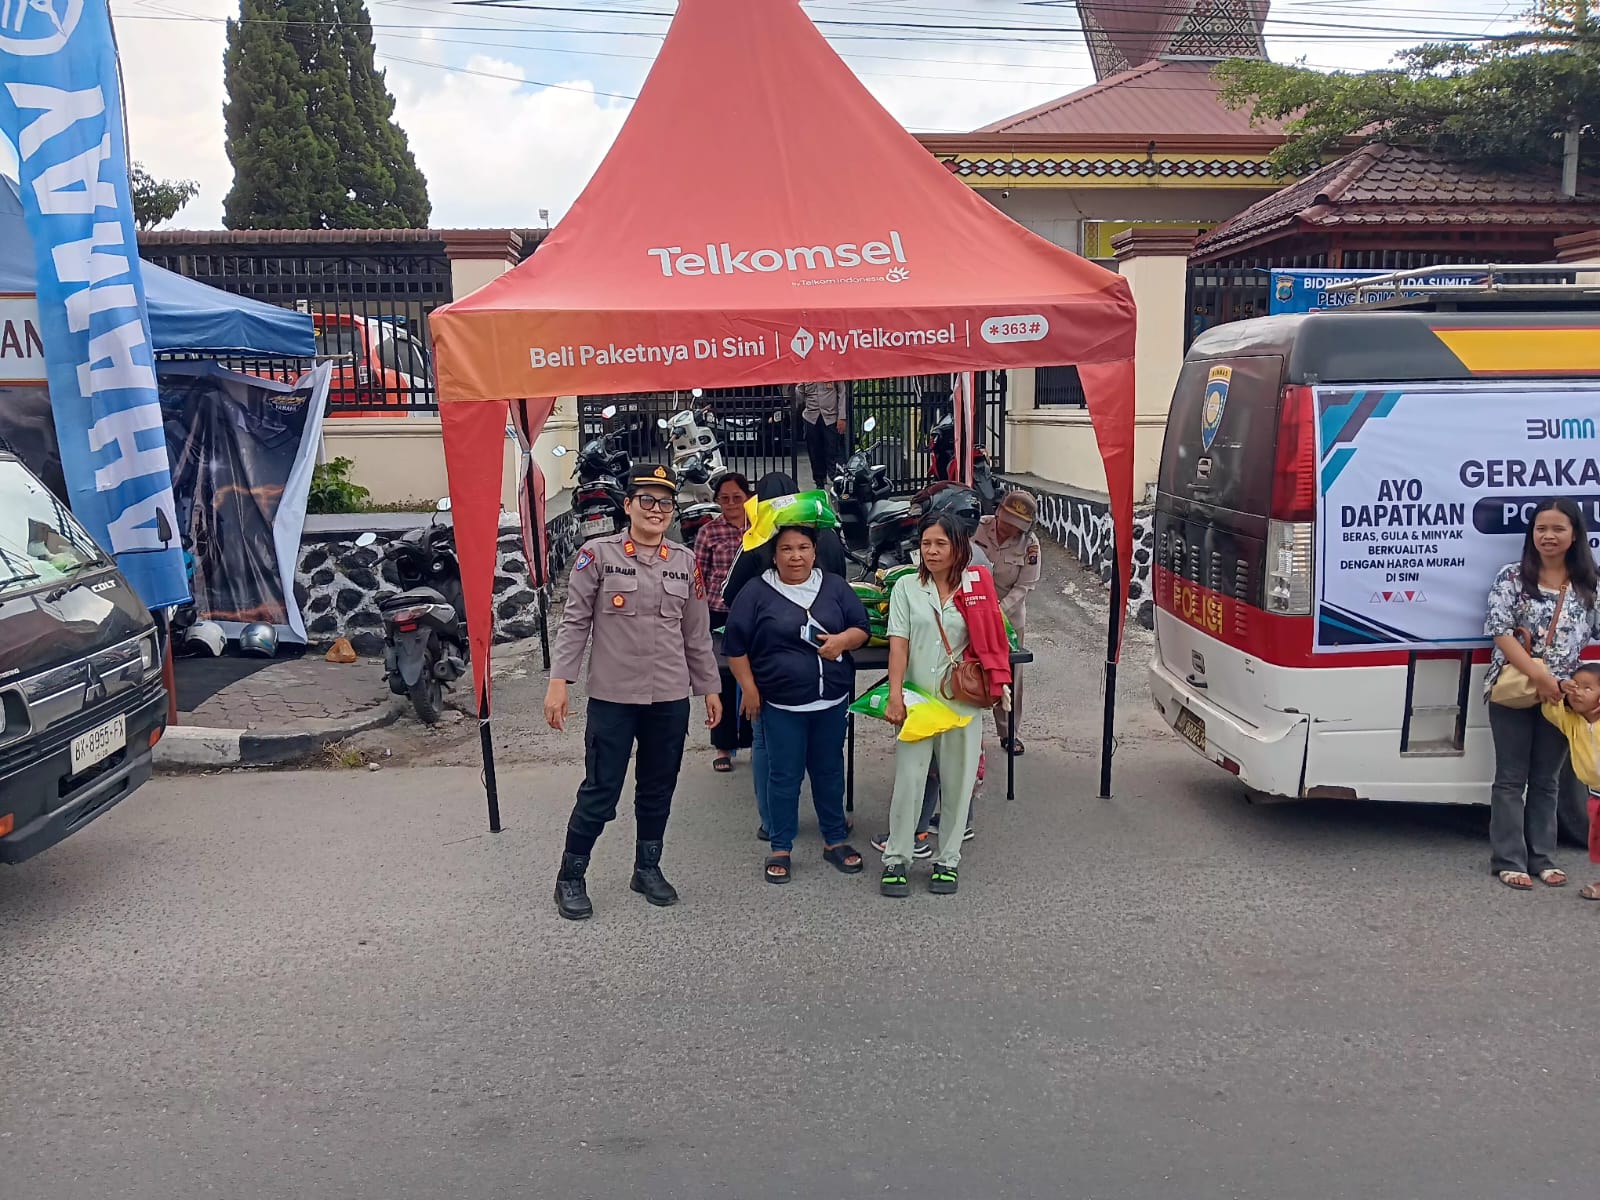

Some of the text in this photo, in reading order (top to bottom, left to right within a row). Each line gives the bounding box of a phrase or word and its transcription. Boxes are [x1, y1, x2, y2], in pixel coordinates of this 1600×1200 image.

[647, 230, 907, 277] Telkomsel
[5, 83, 181, 555] YAMAHA
[818, 323, 956, 355] MyTelkomsel
[529, 335, 765, 369] Beli Paketnya Di Sini
[1377, 478, 1423, 502] AYO
[1341, 503, 1465, 528] DAPATKAN
[1342, 530, 1463, 542] BERAS, GULA & MINYAK
[1368, 544, 1438, 555] BERKUALITAS
[662, 570, 689, 581] POLRI
[1340, 557, 1465, 570] DENGAN HARGA MURAH
[91, 580, 117, 593] COLT
[1386, 572, 1419, 582] DI SINI
[1173, 579, 1223, 634] POLISI
